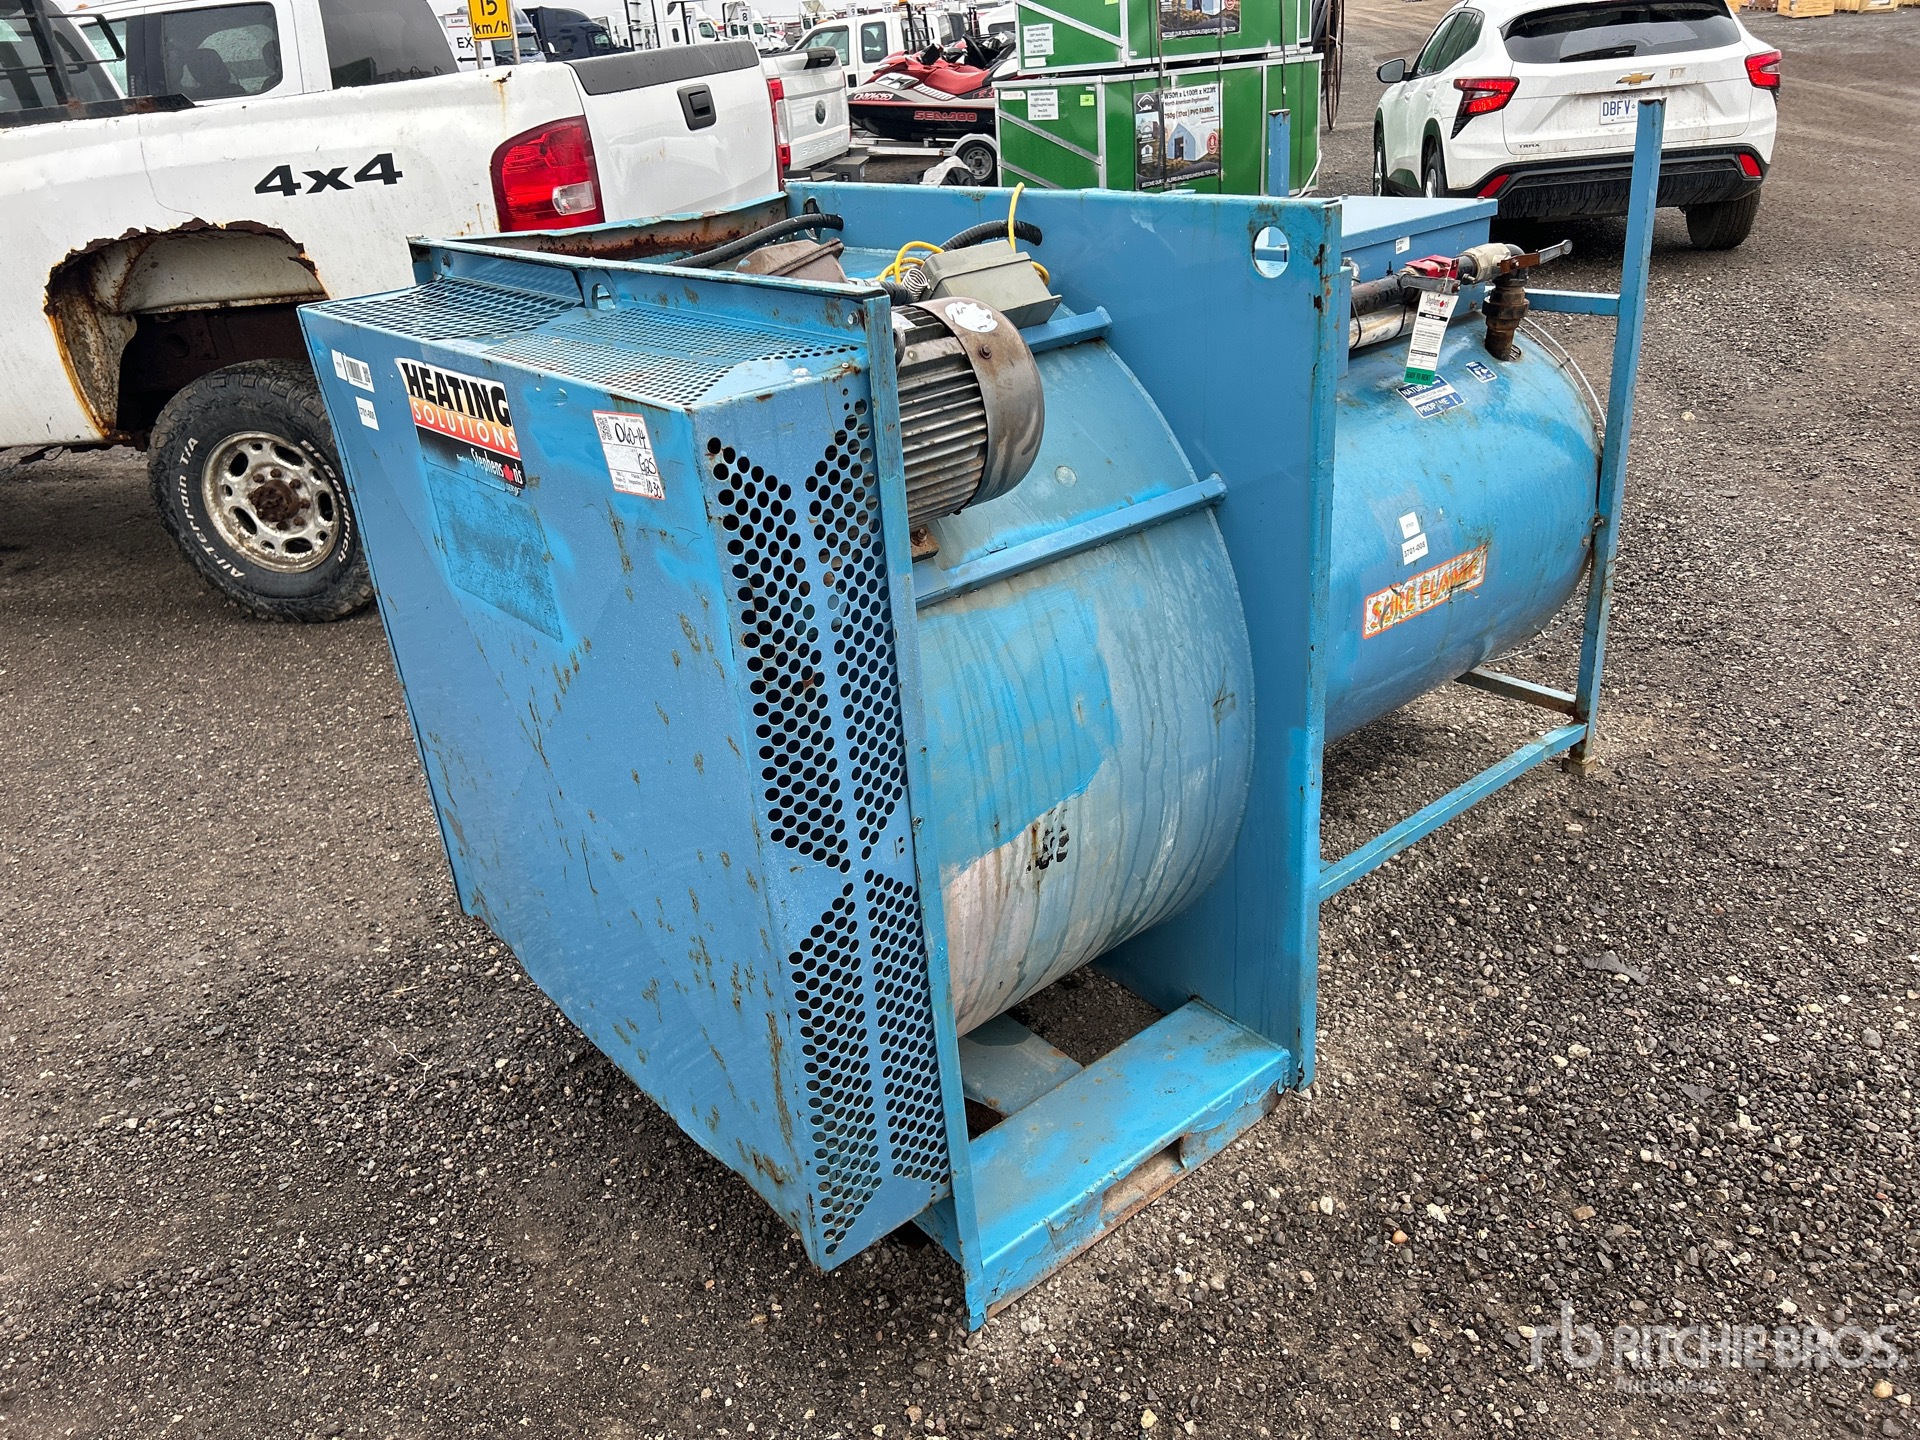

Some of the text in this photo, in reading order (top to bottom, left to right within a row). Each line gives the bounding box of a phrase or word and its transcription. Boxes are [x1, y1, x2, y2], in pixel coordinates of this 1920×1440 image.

[474, 20, 509, 35] km/h
[479, 0, 498, 16] 15
[456, 36, 474, 49] EX
[254, 152, 404, 197] 4x4
[401, 362, 513, 428] HEATING
[412, 401, 519, 453] SOLUTIONS
[1369, 586, 1416, 629] SURE
